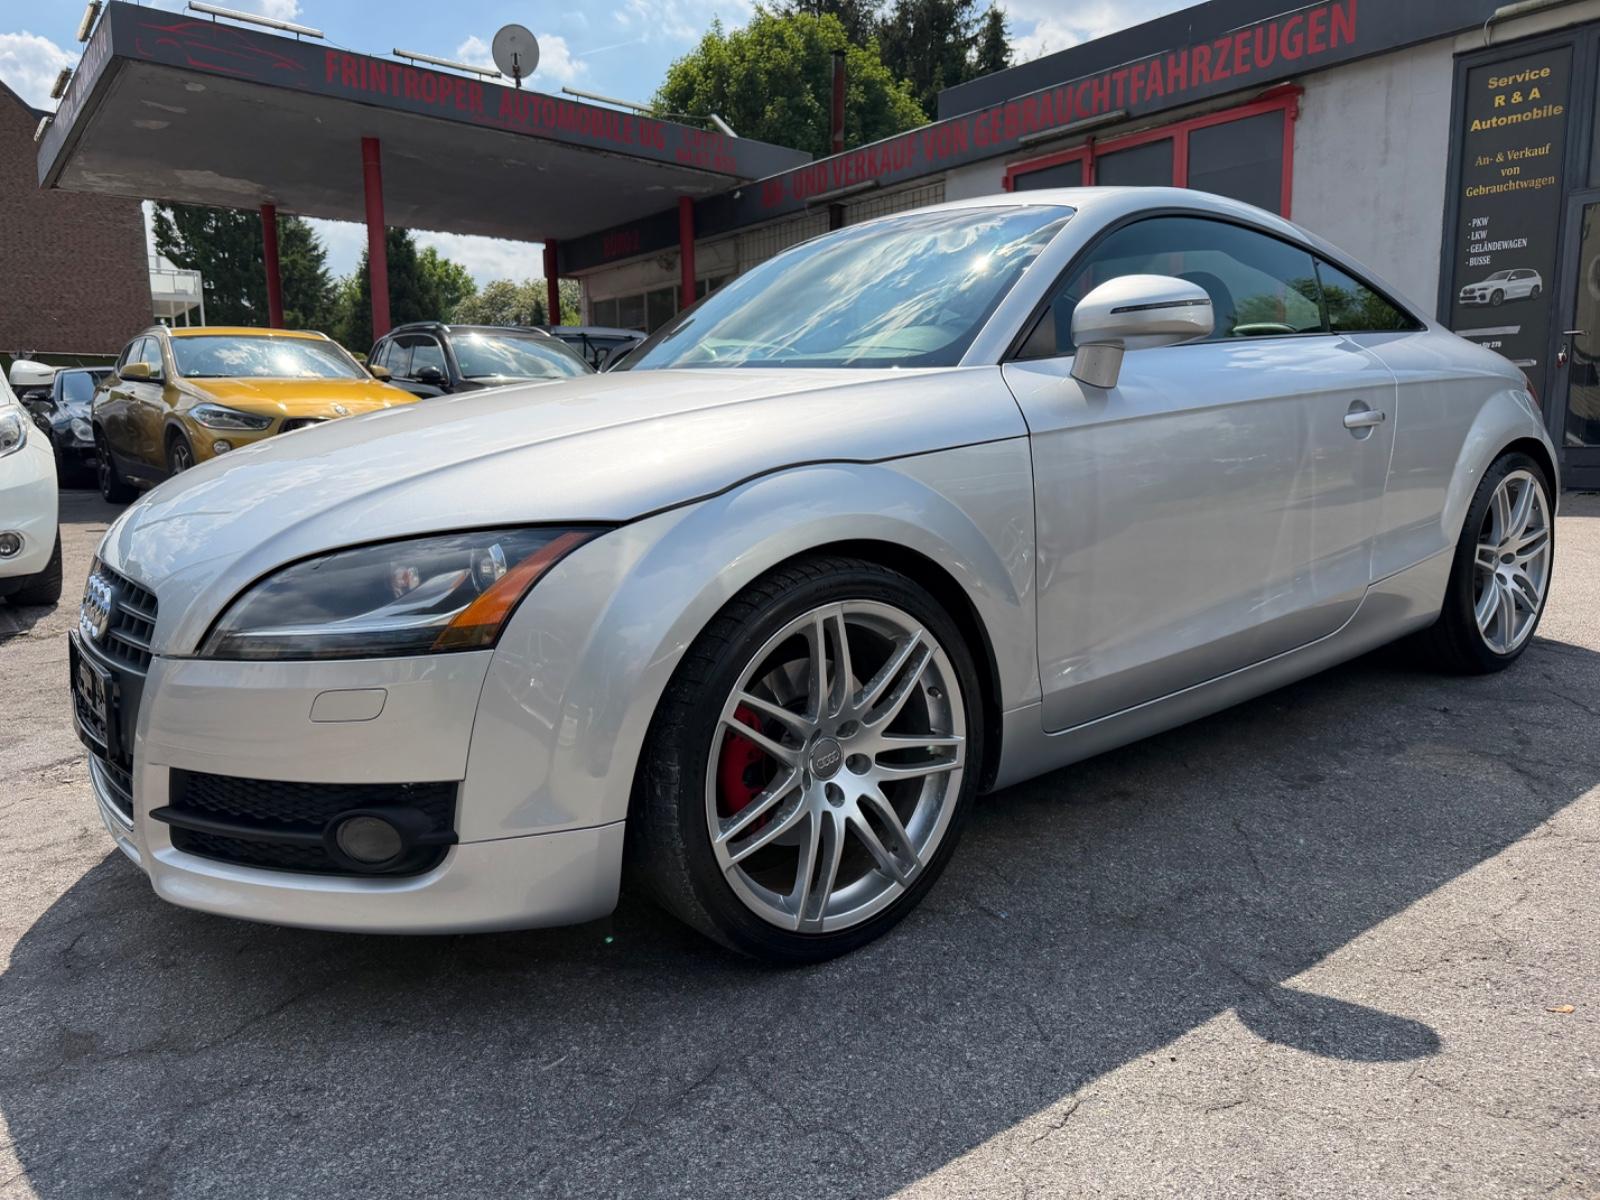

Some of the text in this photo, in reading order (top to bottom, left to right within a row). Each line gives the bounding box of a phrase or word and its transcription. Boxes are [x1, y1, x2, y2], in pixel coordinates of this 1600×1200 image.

[1487, 67, 1551, 89] Service
[325, 50, 484, 113] FRINTROPER
[499, 88, 634, 144] AUTOMOBILE
[639, 119, 665, 150] UG
[793, 164, 828, 200] UND
[832, 134, 917, 189] VERKAUF
[922, 118, 969, 162] VON
[973, 0, 1358, 148] GEBRAUCHTFAHRZEUGEN
[1494, 87, 1541, 108] R & A
[1470, 104, 1564, 132] Automobile
[1475, 143, 1552, 167] An- & Verkauf
[1501, 166, 1521, 177] von
[1465, 176, 1555, 197] Gebrauchtwagen
[1472, 216, 1490, 228] PKW
[1470, 236, 1528, 254] GELÄNDEWAGEN
[1471, 230, 1488, 241] LKW
[1469, 255, 1491, 267] BUSSE
